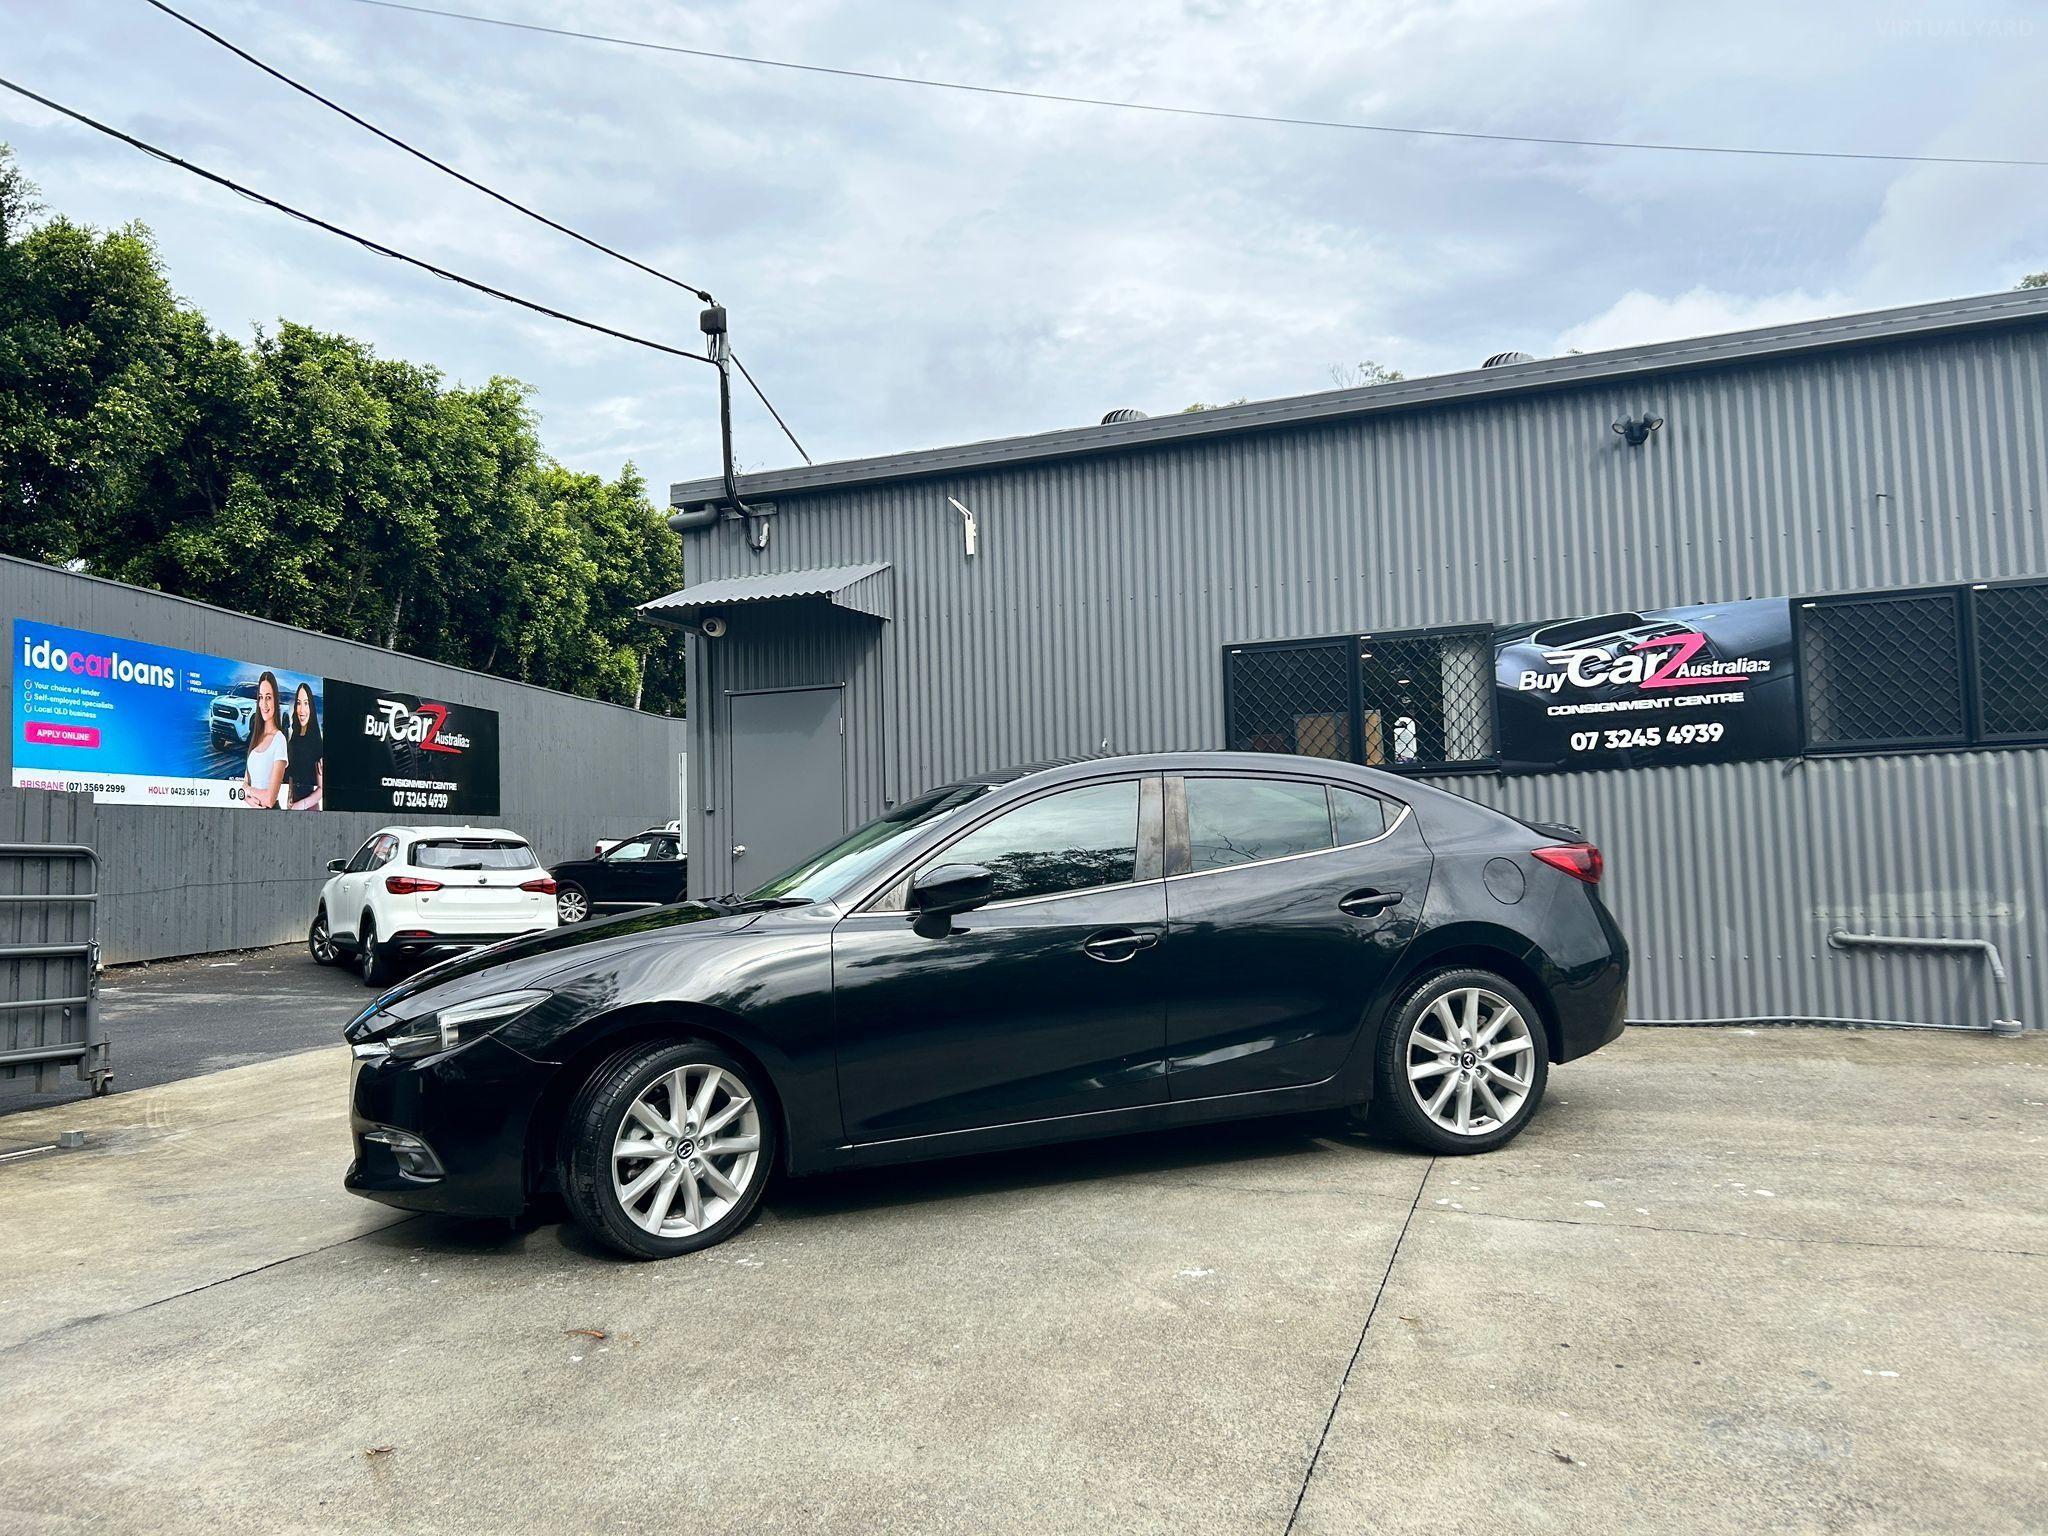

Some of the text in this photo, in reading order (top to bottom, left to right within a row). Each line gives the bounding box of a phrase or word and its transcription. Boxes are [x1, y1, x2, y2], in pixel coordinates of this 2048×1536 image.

[24, 636, 175, 689] idocarloans
[1518, 669, 1568, 694] Buy
[1675, 657, 1758, 678] Australia
[34, 681, 100, 697] Your choice of lender
[34, 693, 114, 710] Self-employed specialists
[1547, 691, 1744, 717] CONSIGNMENT CENTRE
[34, 704, 97, 718] Local QLD business
[37, 728, 90, 741] APPLY ONLINE
[364, 714, 389, 742] Buy
[435, 731, 464, 747] Australia
[1570, 723, 1724, 751] 07 3245 4939
[20, 780, 125, 793] BRISBANE (07) 3569 2999
[148, 786, 169, 795] HOLLY
[170, 787, 186, 796] 0423
[187, 788, 198, 796] 961
[381, 777, 458, 791] CONSIGNMENT CENTRE
[393, 790, 448, 809] 07 3245 4939
